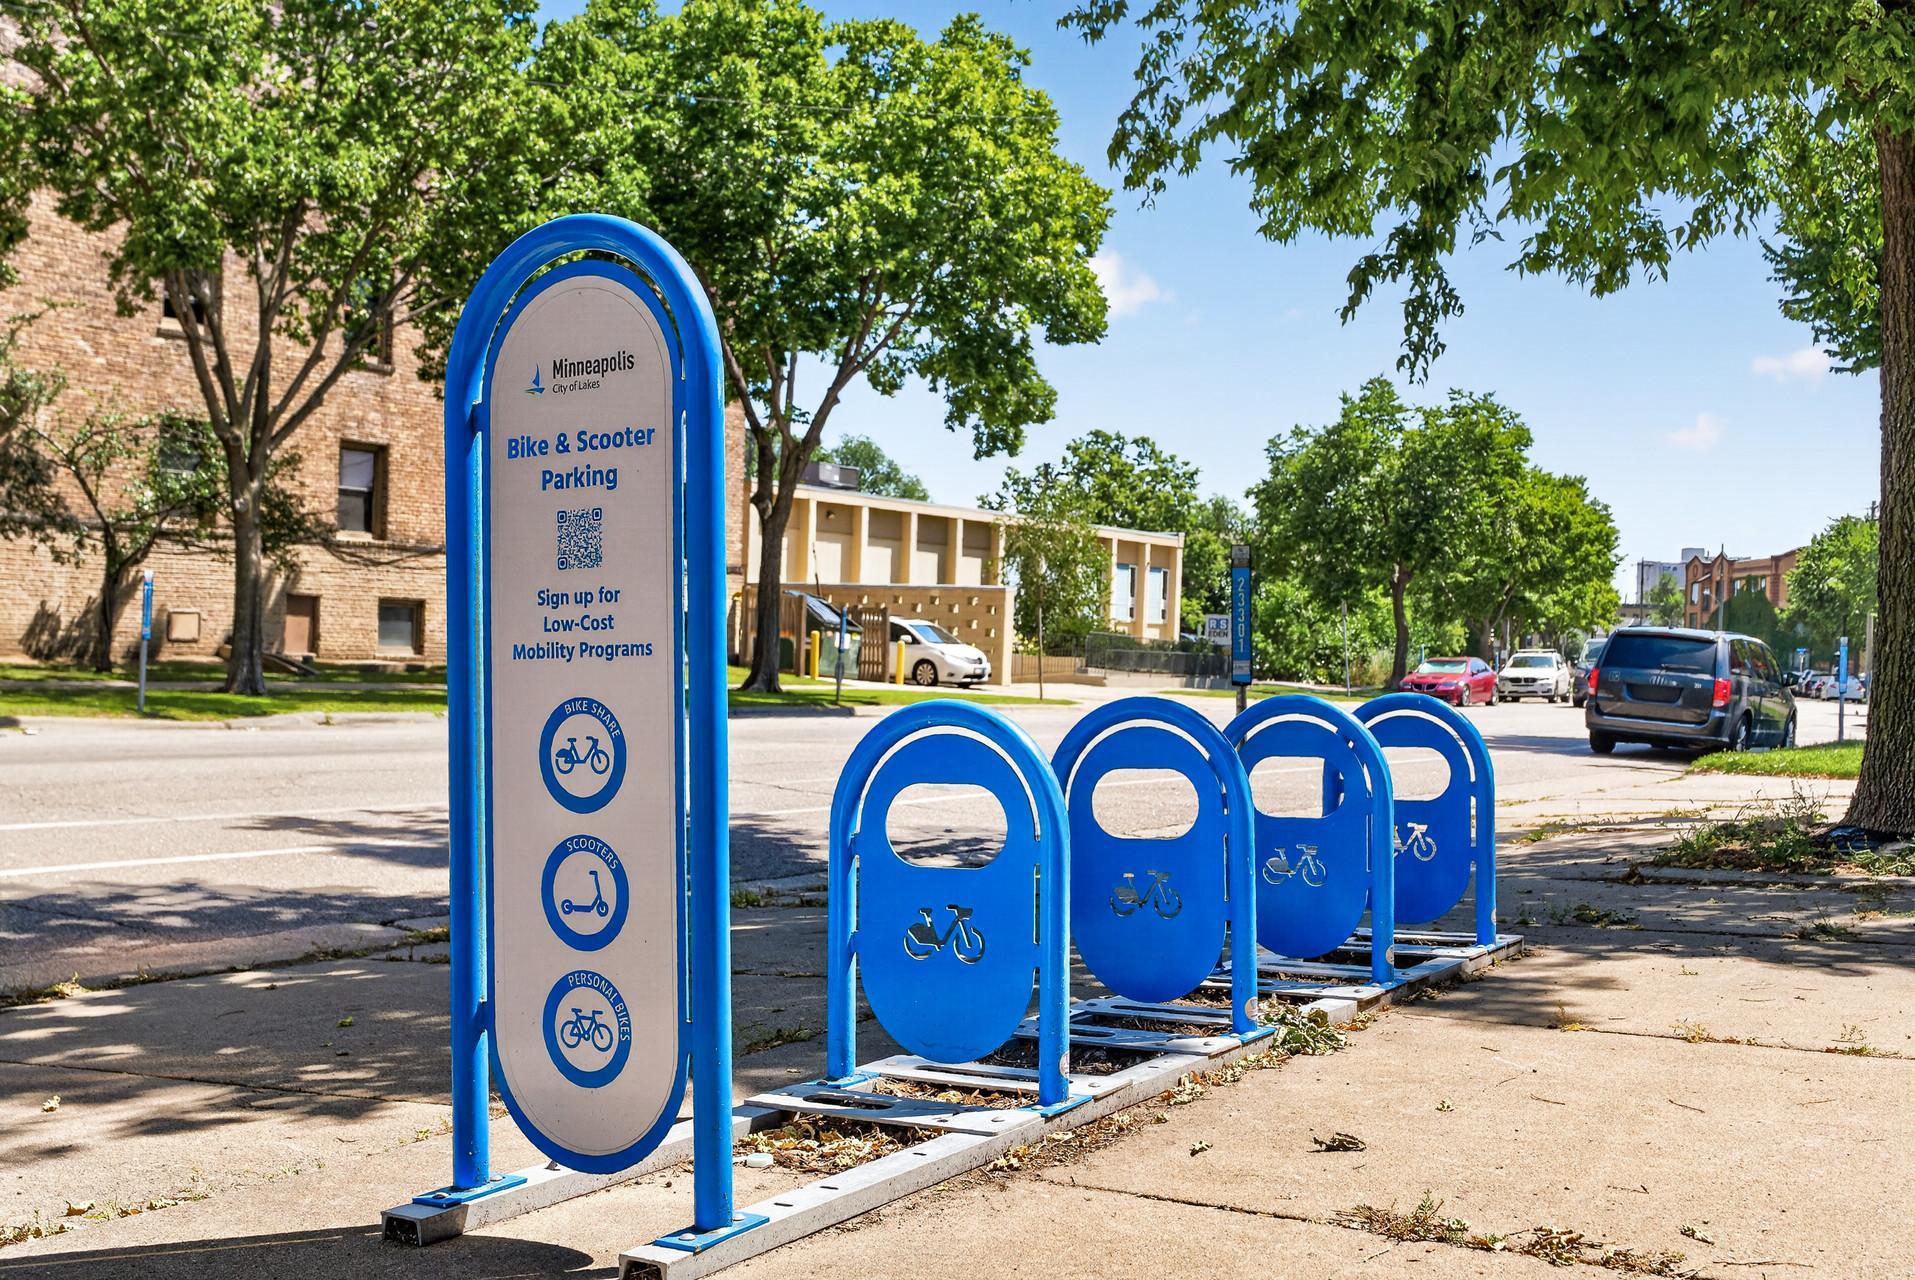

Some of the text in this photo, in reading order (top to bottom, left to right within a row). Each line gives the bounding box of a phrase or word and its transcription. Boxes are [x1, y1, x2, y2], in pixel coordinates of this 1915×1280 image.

[553, 351, 634, 379] Minneapolis
[552, 379, 600, 395] City of Lakes
[507, 427, 655, 459] Bike & Scooter
[542, 464, 617, 491] Parking
[537, 586, 620, 609] Sign up for
[543, 614, 614, 632] Low-Cost
[513, 642, 652, 662] Mobility Programs
[564, 700, 621, 738] BIKE SHARE
[566, 838, 619, 869] SCOOTERS
[568, 972, 630, 1041] PERSONAL BIKES
